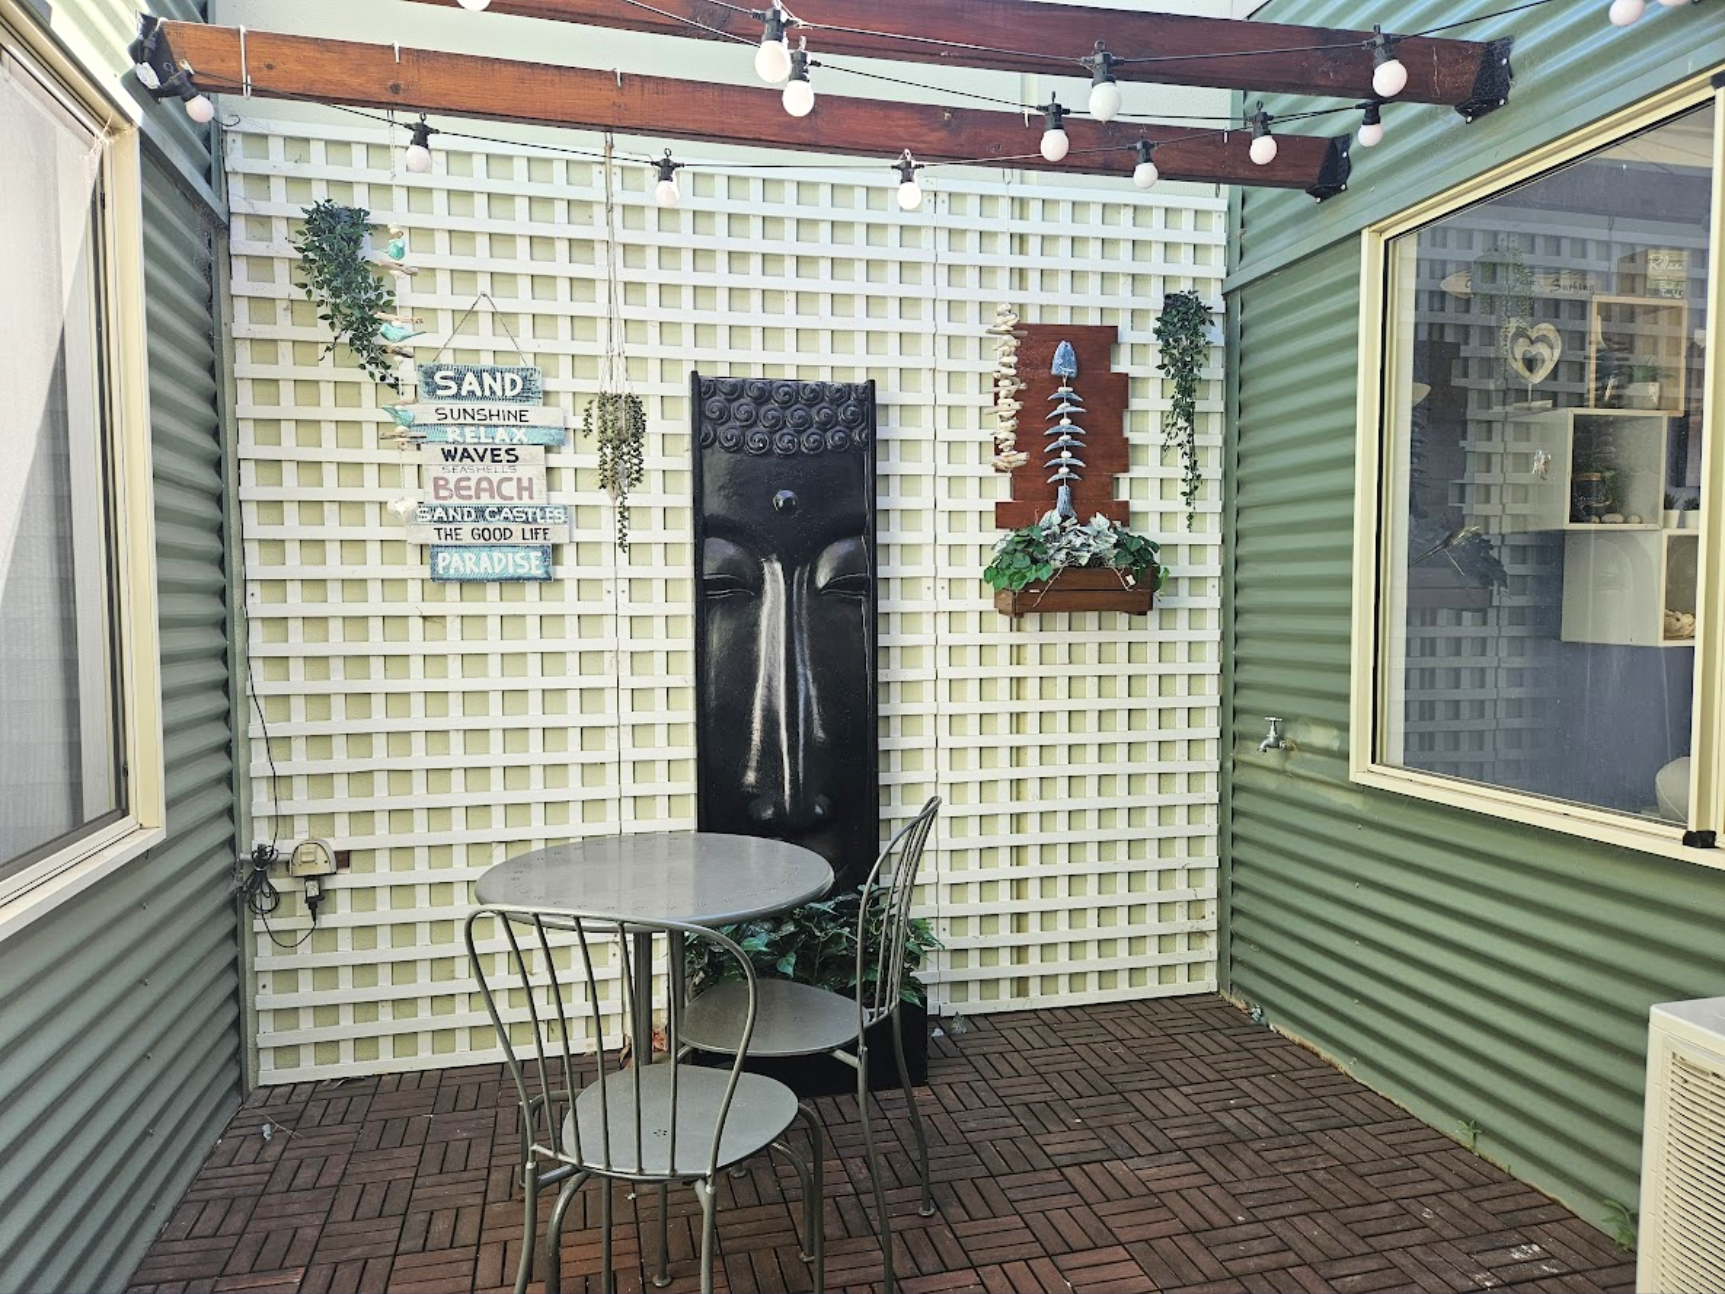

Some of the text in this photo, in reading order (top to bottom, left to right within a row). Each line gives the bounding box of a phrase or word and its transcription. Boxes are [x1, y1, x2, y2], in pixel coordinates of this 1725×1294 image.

[433, 370, 523, 397] SAND
[435, 407, 530, 422] SUNSHINE
[447, 426, 529, 443] RELAX
[441, 446, 520, 463] WAVES
[442, 465, 518, 473] SEASHELLS
[433, 476, 535, 500] BEACH
[416, 507, 566, 523] SAND CASTLES
[433, 527, 551, 542] THE GOOD LIFE
[437, 551, 543, 574] PARADISE
